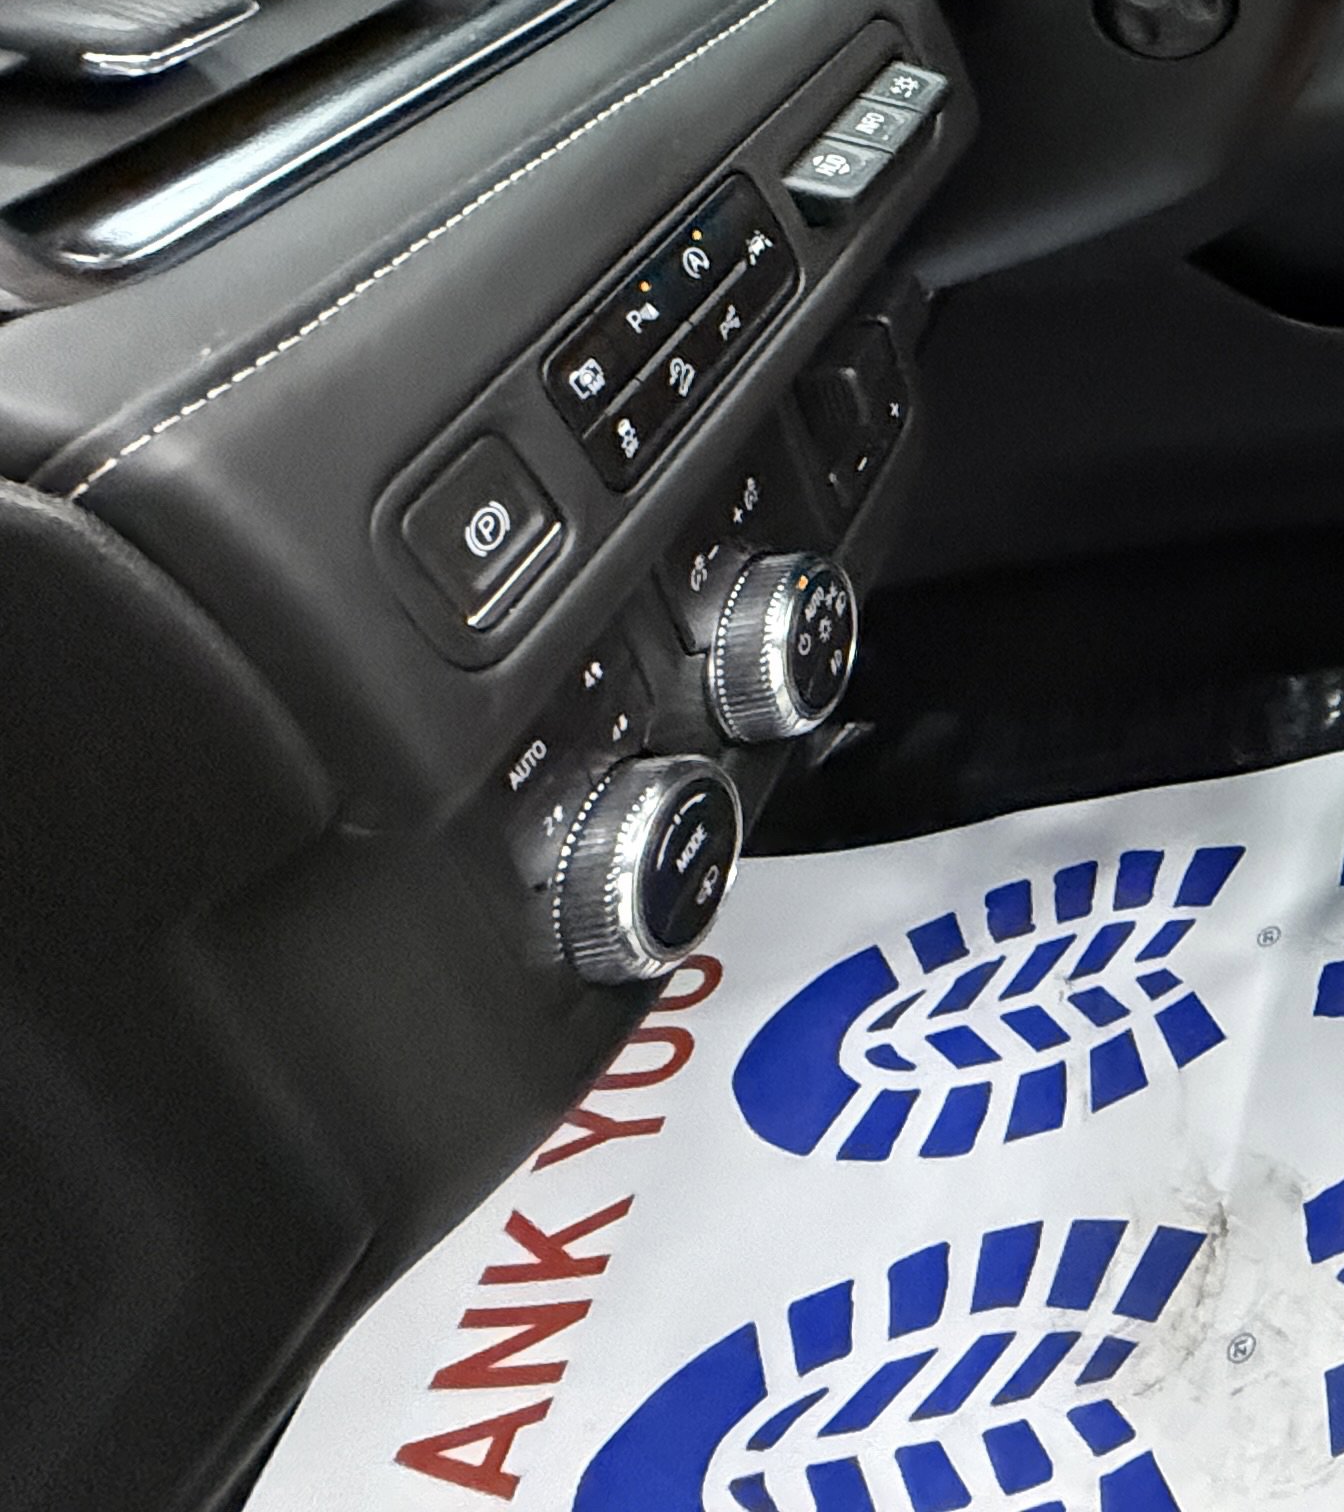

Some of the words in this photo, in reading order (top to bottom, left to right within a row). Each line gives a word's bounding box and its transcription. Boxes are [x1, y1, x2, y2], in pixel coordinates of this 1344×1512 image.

[815, 154, 846, 177] HUD
[508, 739, 548, 791] AUTO
[675, 823, 708, 875] MODE
[394, 1194, 635, 1501] ANK
